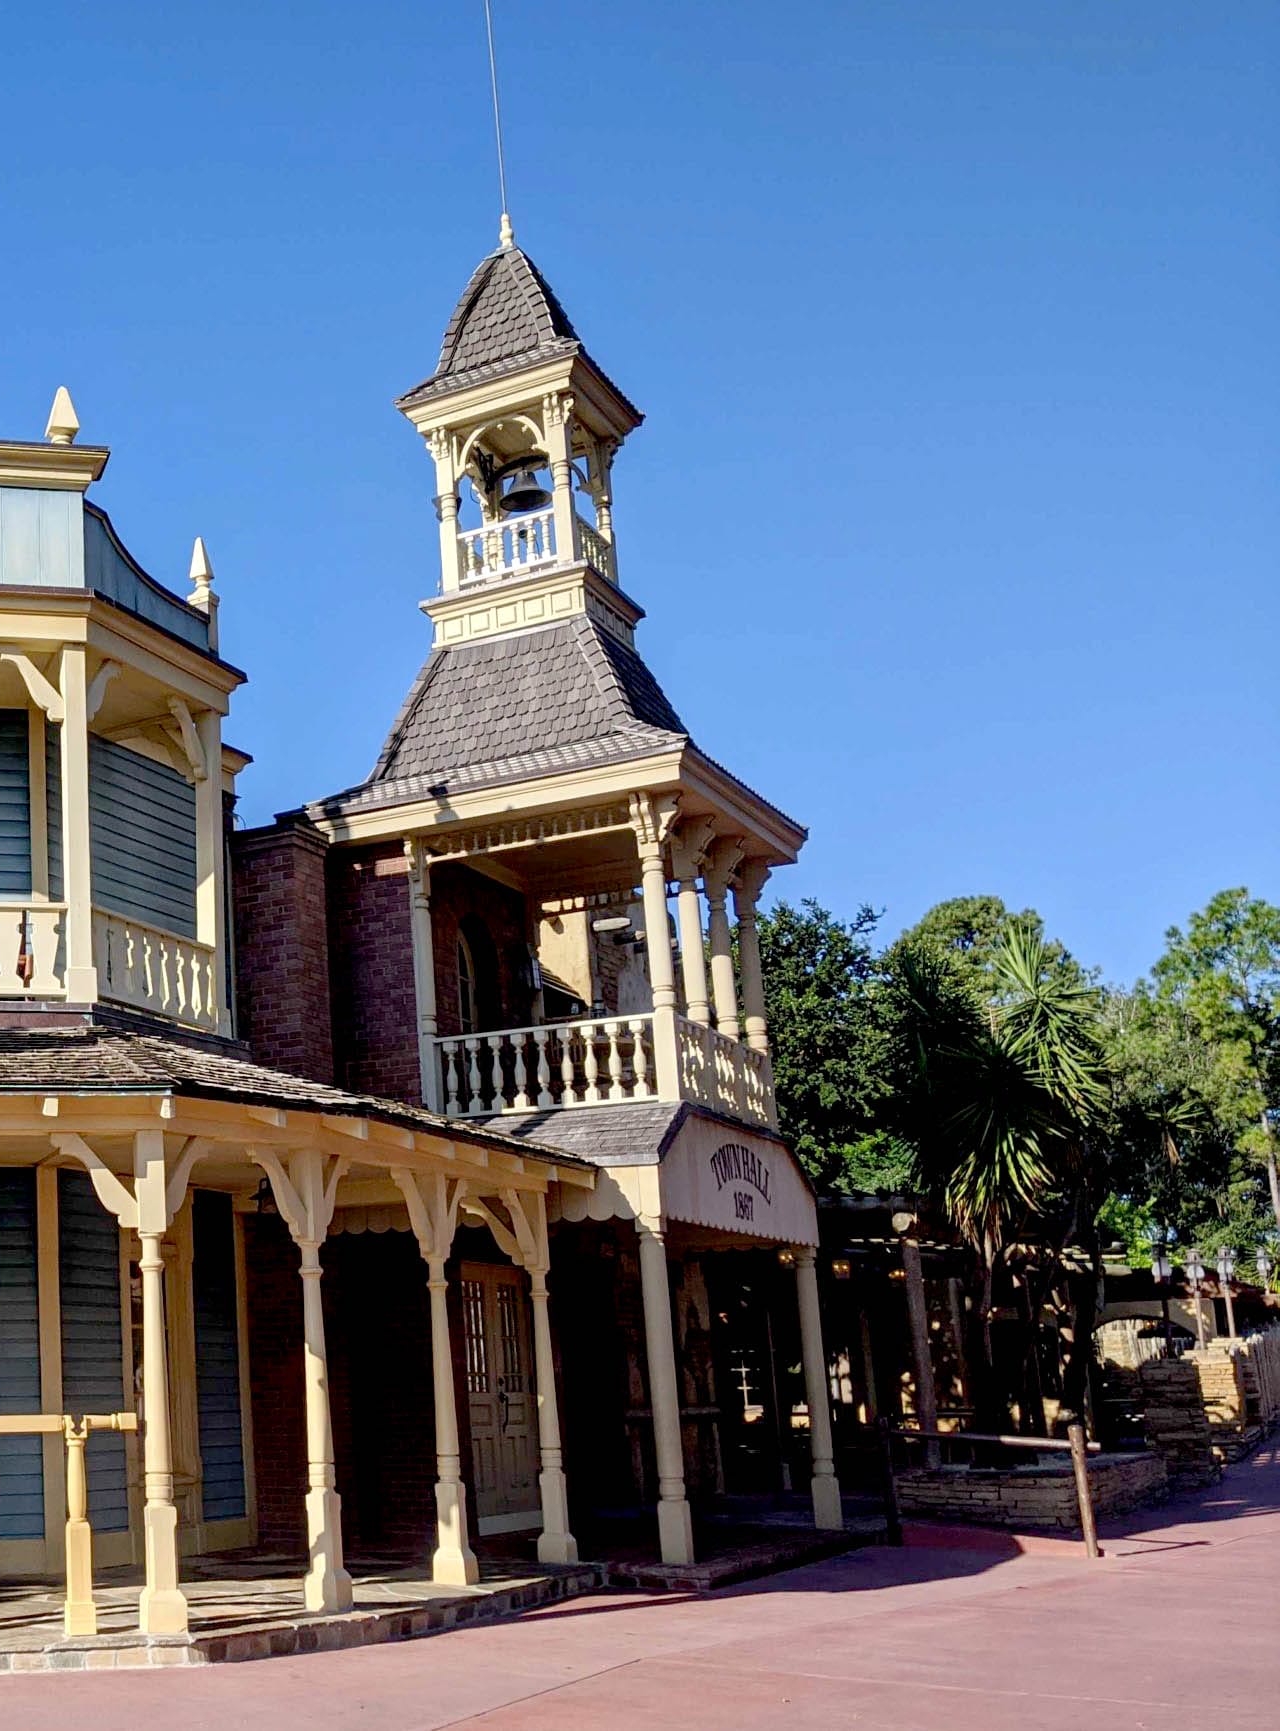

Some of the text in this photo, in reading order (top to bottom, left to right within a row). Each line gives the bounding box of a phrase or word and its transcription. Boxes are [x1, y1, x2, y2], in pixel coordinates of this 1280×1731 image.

[710, 1143, 771, 1206] TOWN HALL
[733, 1192, 753, 1222] 1867
